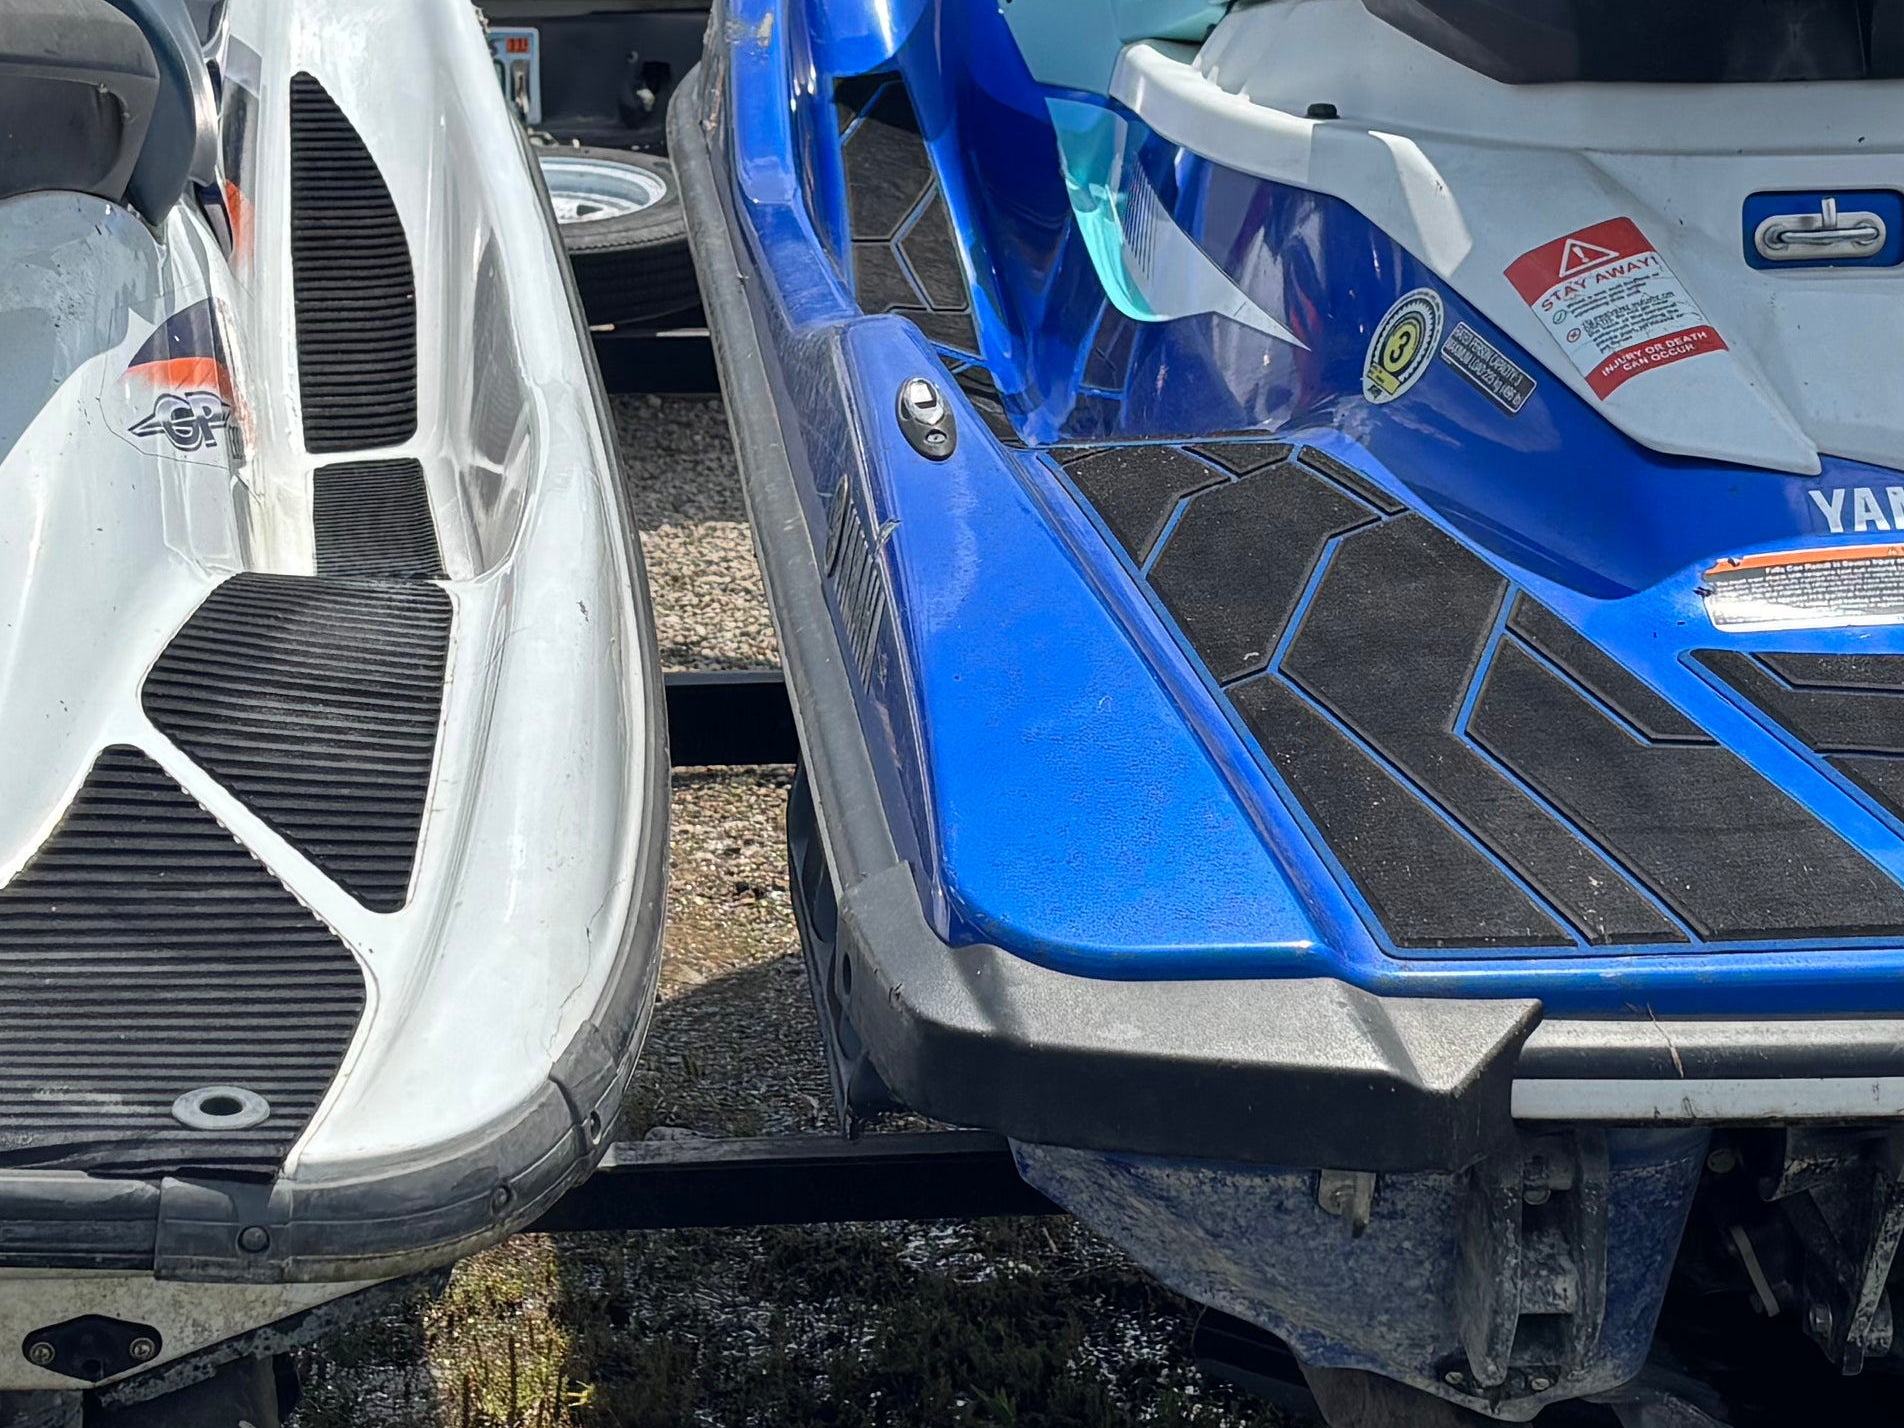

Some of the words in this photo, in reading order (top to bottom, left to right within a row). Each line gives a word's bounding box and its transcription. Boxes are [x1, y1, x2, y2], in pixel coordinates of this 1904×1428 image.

[1541, 278, 1587, 312] STAY
[1596, 255, 1659, 284] AWAY!
[1389, 331, 1412, 364] 3
[1602, 349, 1643, 377] INJURY
[1644, 342, 1665, 356] OR
[1665, 330, 1708, 349] DEATH
[1622, 357, 1650, 372] CAN
[1650, 343, 1696, 362] OCCUR
